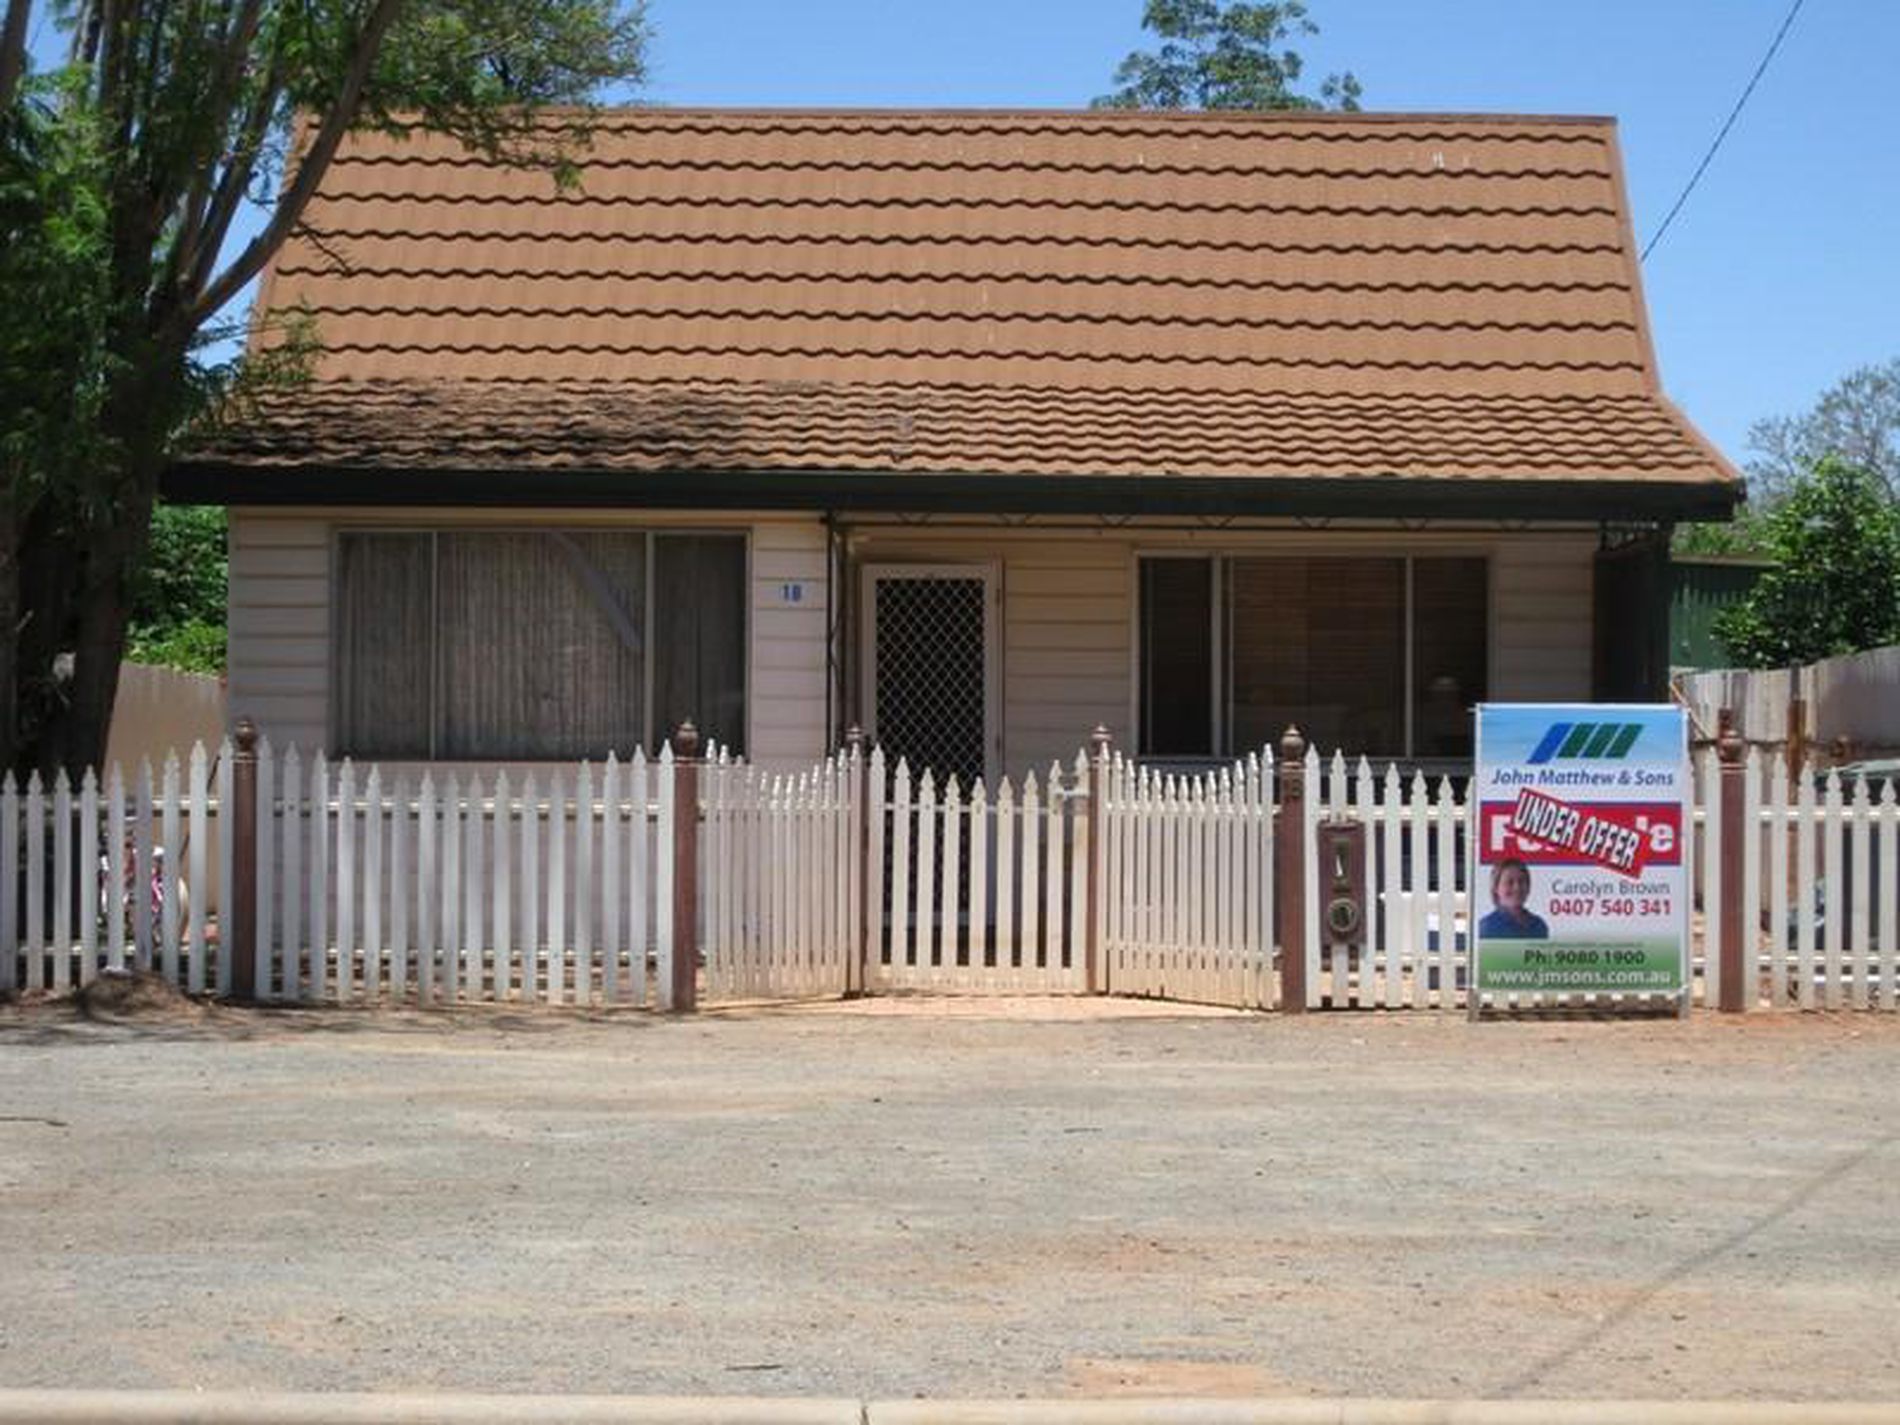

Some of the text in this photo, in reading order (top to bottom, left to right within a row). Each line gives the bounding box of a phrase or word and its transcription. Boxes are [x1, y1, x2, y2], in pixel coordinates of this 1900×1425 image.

[1491, 770, 1673, 785] John Matthew & Sons
[1514, 791, 1580, 847] UNDER
[1579, 816, 1640, 869] OFFER
[1551, 880, 1670, 897] Carolyn Brown
[1550, 899, 1671, 915] 0407 540 341
[1554, 950, 1599, 965] 9080
[1605, 950, 1645, 965] 1900
[1487, 969, 1671, 985] www.jmsons.com.au
